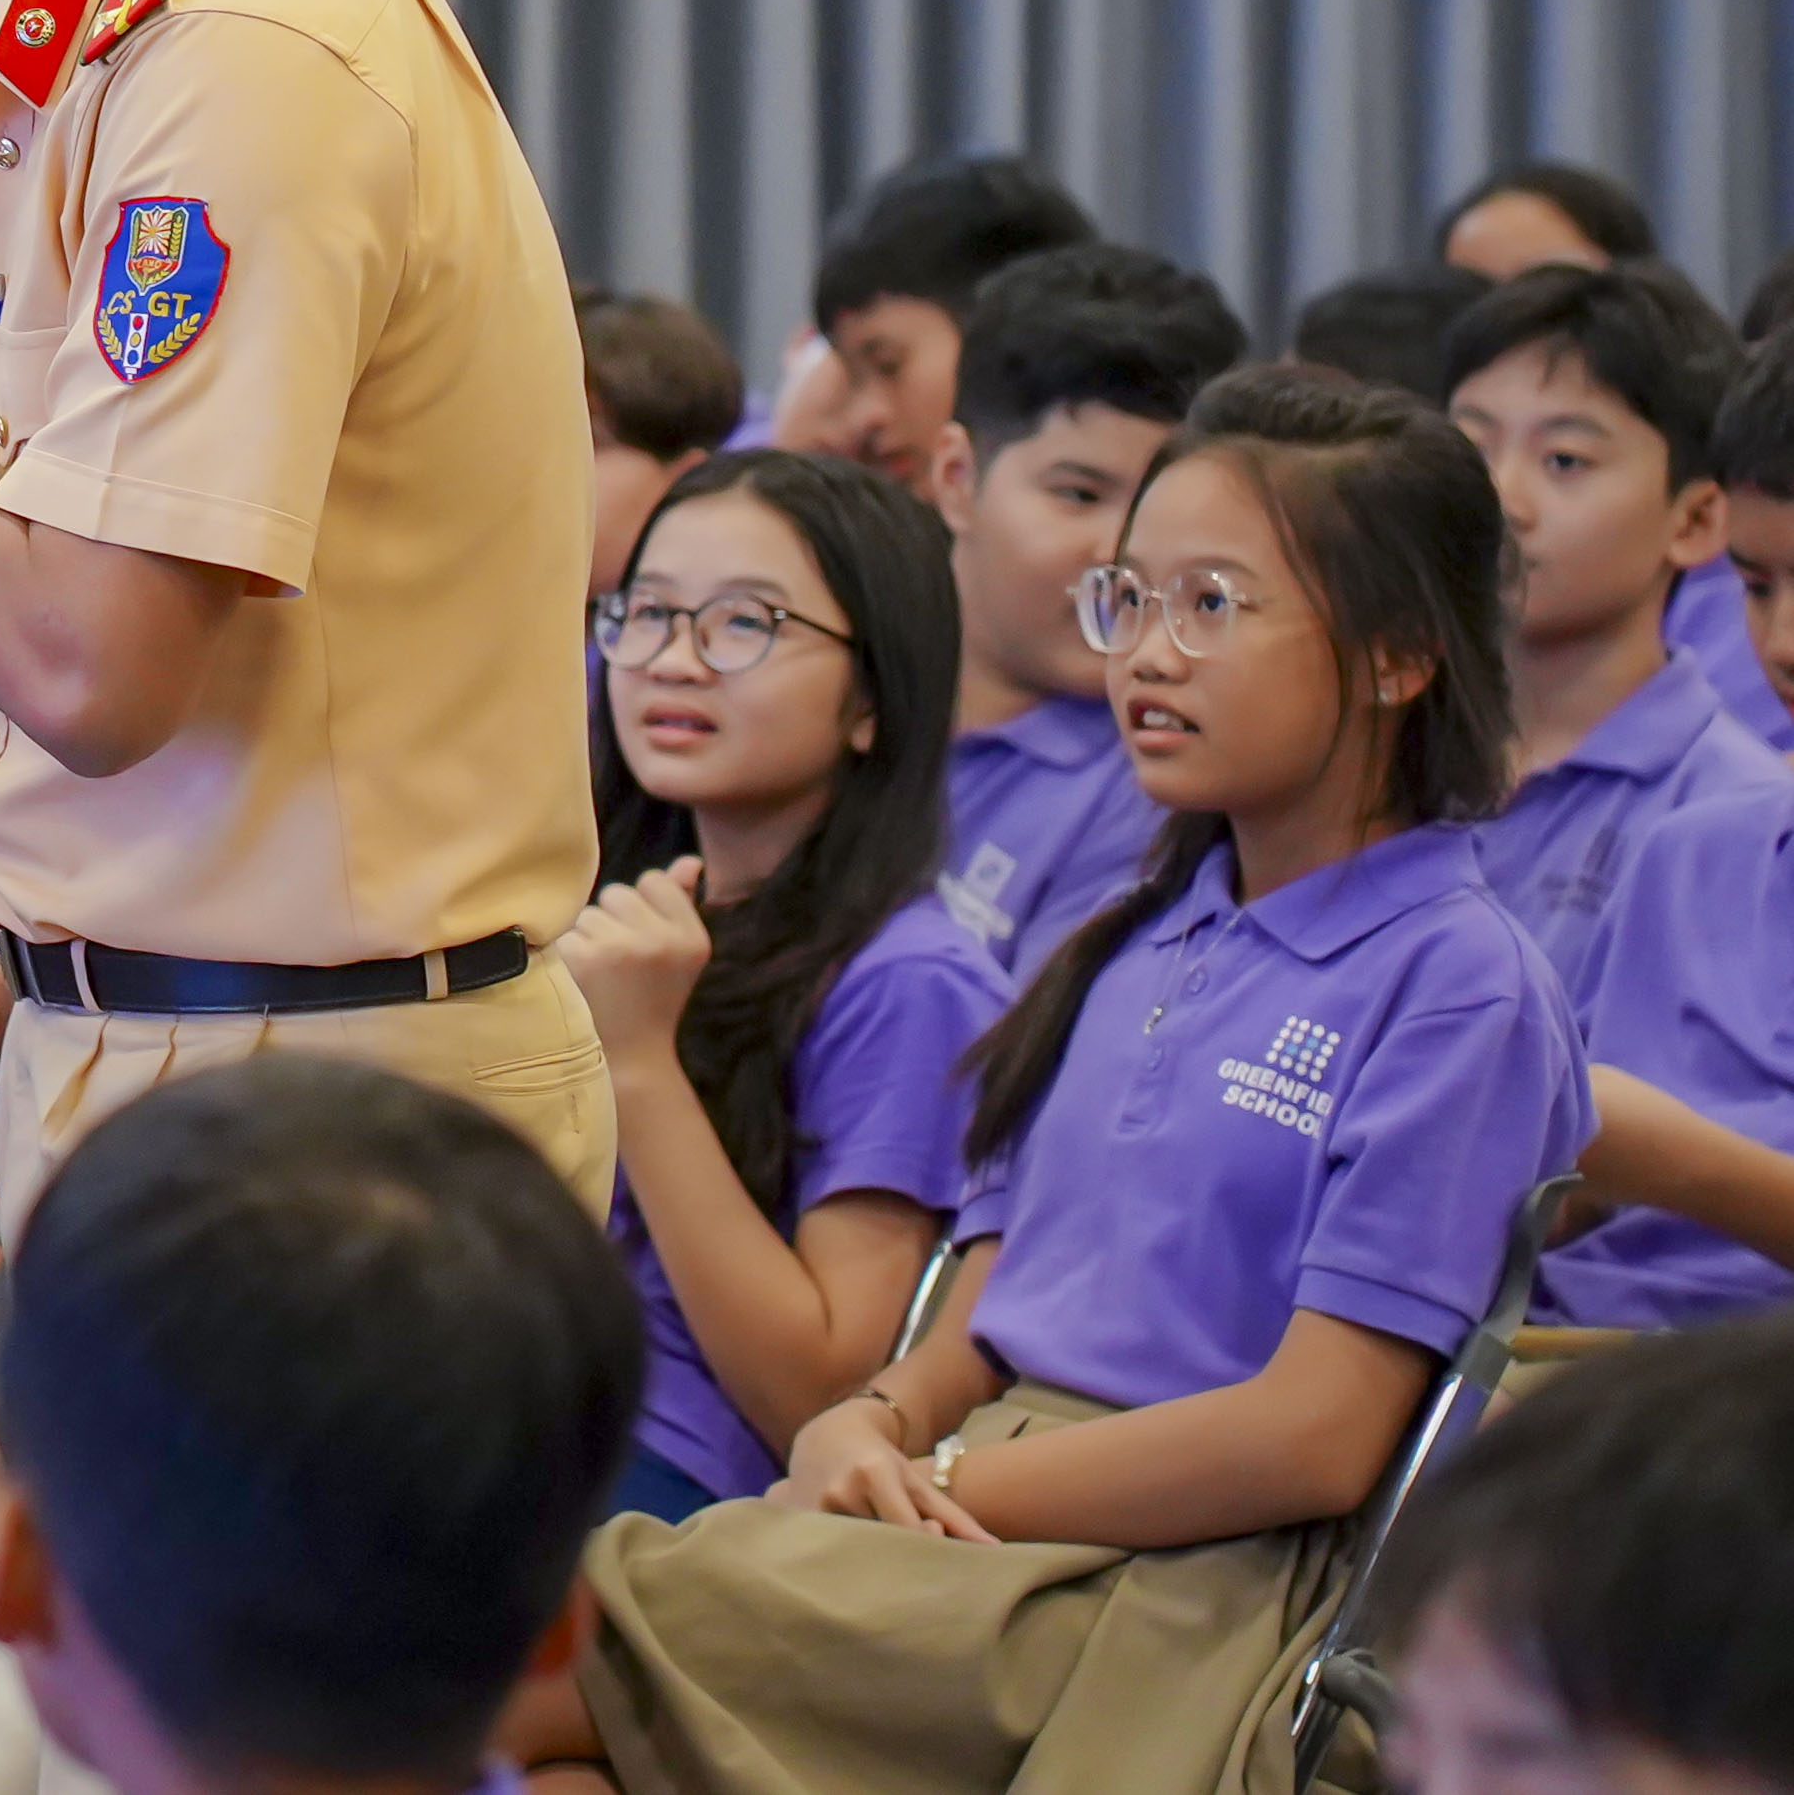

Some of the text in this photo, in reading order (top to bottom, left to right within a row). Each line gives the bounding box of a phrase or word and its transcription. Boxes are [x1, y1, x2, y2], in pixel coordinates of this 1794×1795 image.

[107, 290, 192, 319] CS GT
[1217, 1058, 1333, 1117] GREENFIE
